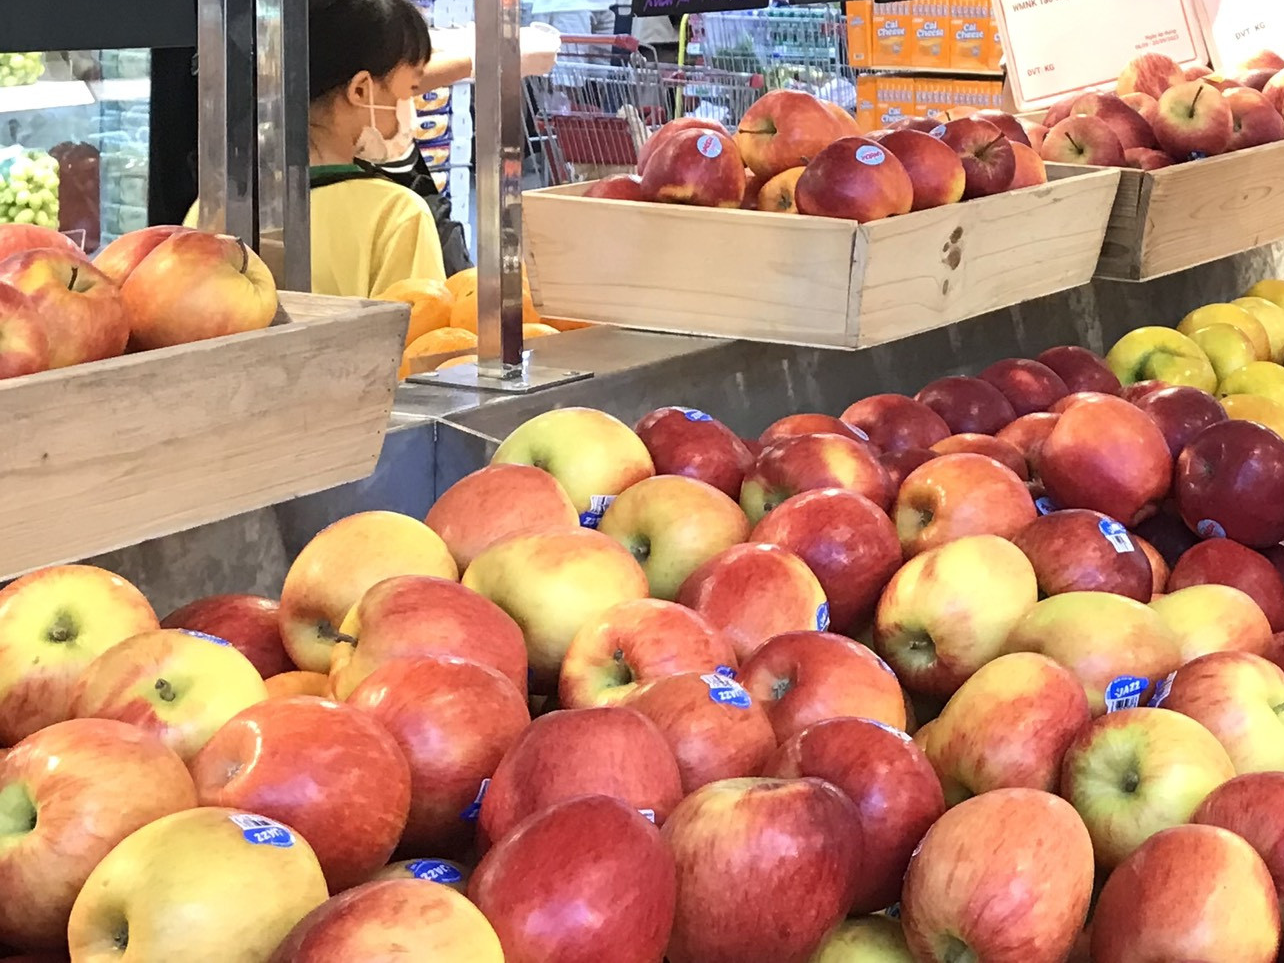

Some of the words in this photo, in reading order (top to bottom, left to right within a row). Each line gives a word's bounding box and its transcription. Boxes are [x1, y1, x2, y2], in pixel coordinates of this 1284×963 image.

[1254, 21, 1266, 32] KG
[1044, 63, 1055, 73] KG
[718, 686, 743, 701] JAZZ
[1115, 680, 1141, 698] JAZZ
[253, 827, 283, 843] JAZZ
[420, 865, 451, 880] JAZZ
